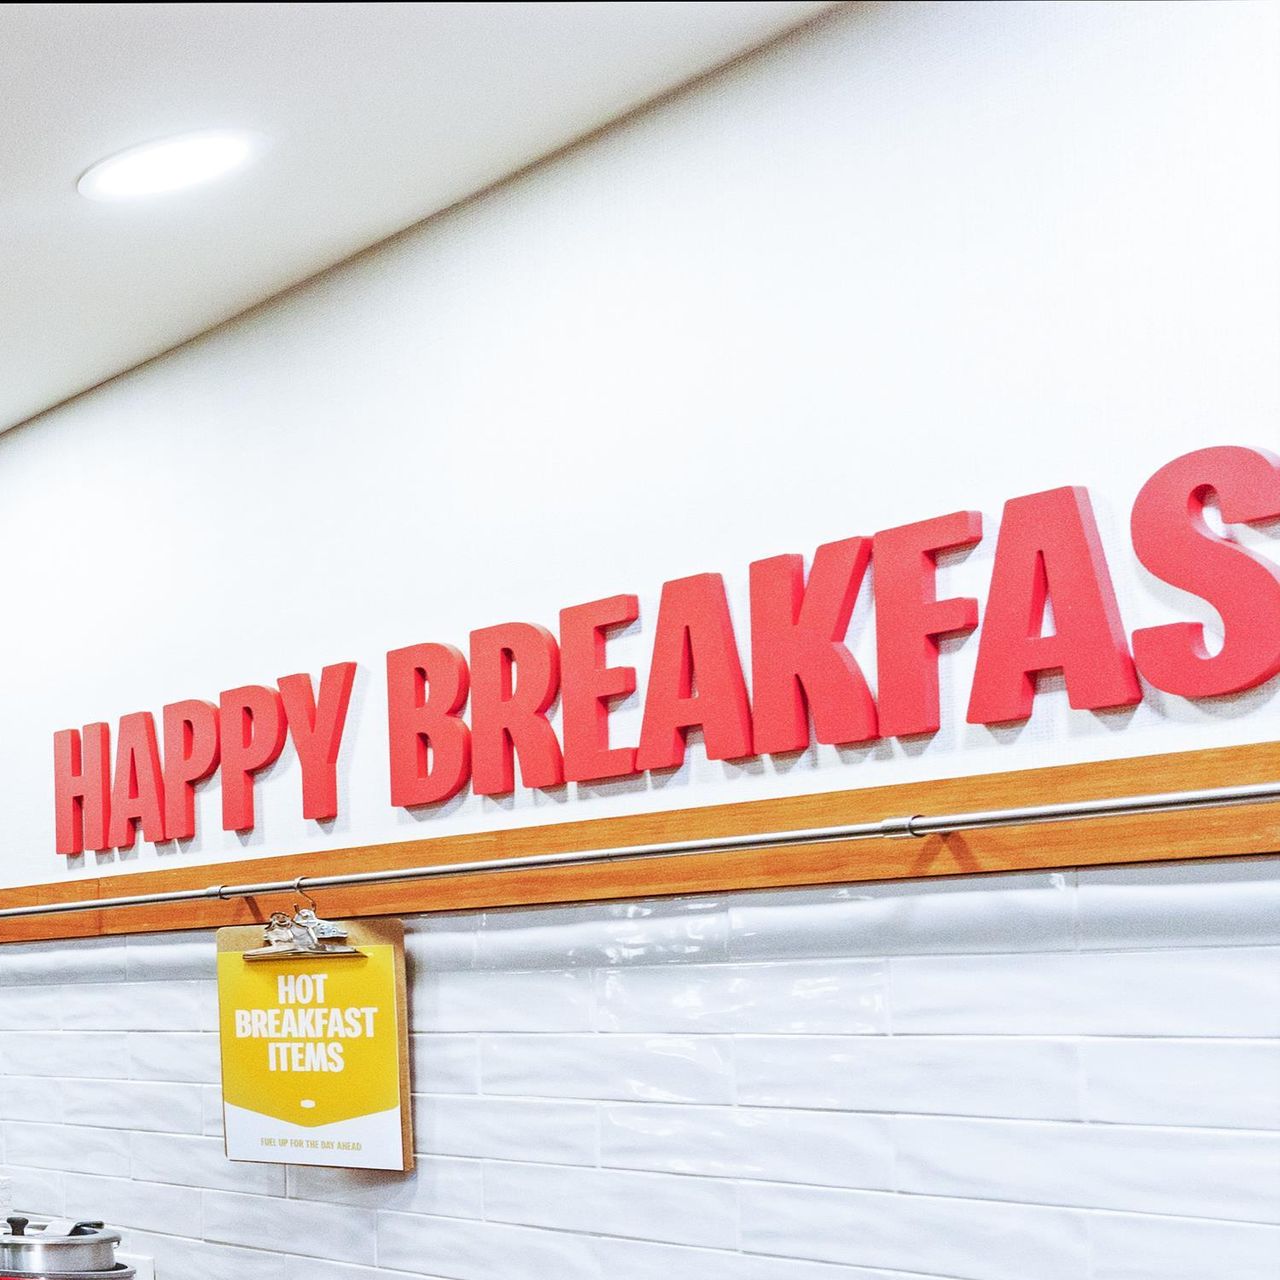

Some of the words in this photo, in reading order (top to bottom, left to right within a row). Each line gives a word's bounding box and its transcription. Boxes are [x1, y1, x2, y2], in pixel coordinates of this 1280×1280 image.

[53, 661, 357, 857] HAPPY
[277, 973, 328, 1005] HOT
[235, 1007, 378, 1039] BREAKFAST
[268, 1042, 345, 1073] ITEMS
